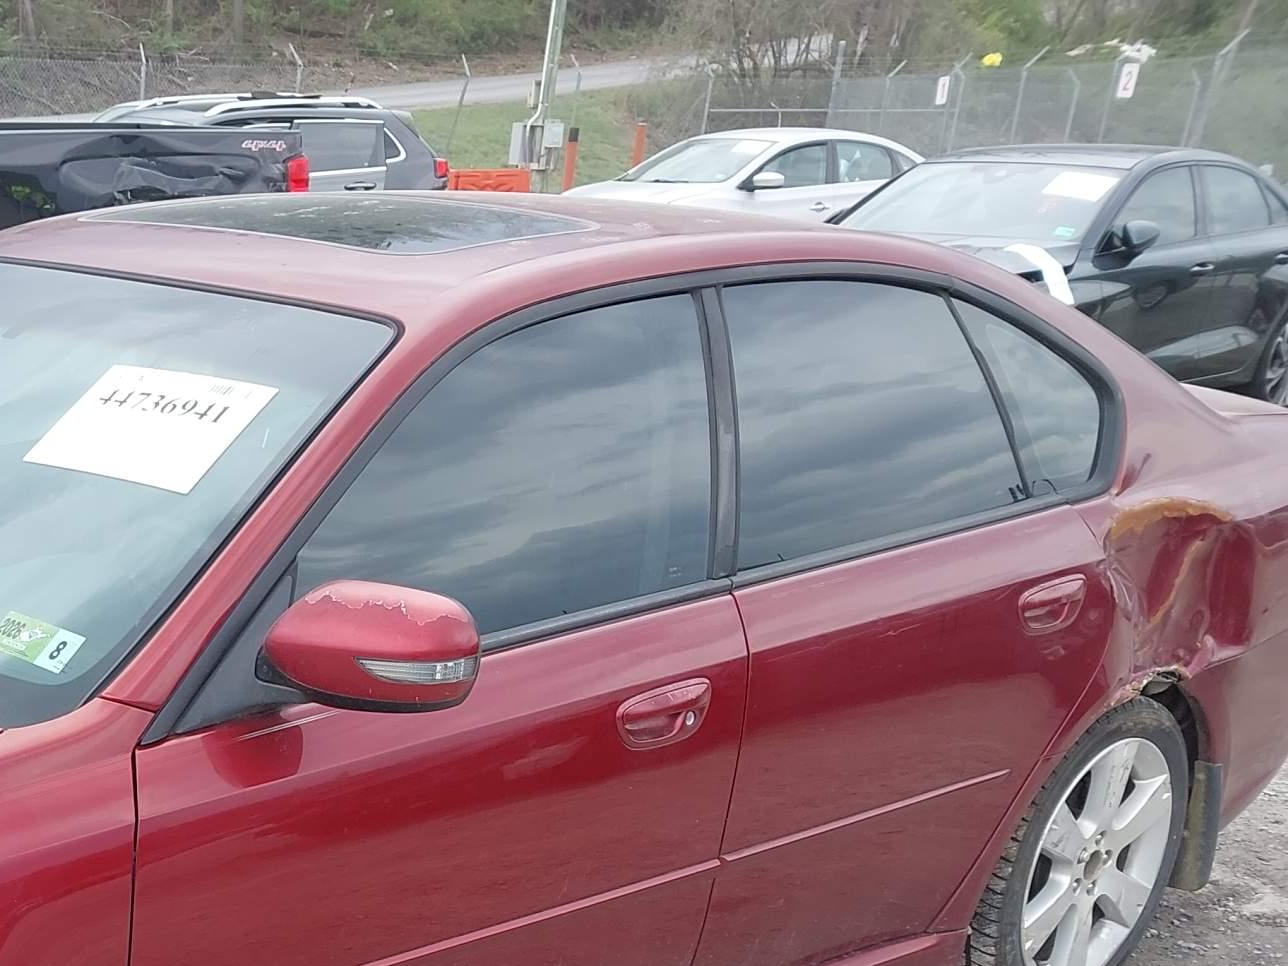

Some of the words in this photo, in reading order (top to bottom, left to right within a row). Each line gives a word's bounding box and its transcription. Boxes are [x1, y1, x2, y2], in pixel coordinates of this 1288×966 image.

[1122, 70, 1133, 91] 2
[98, 388, 230, 424] 44736941
[49, 640, 68, 660] 8
